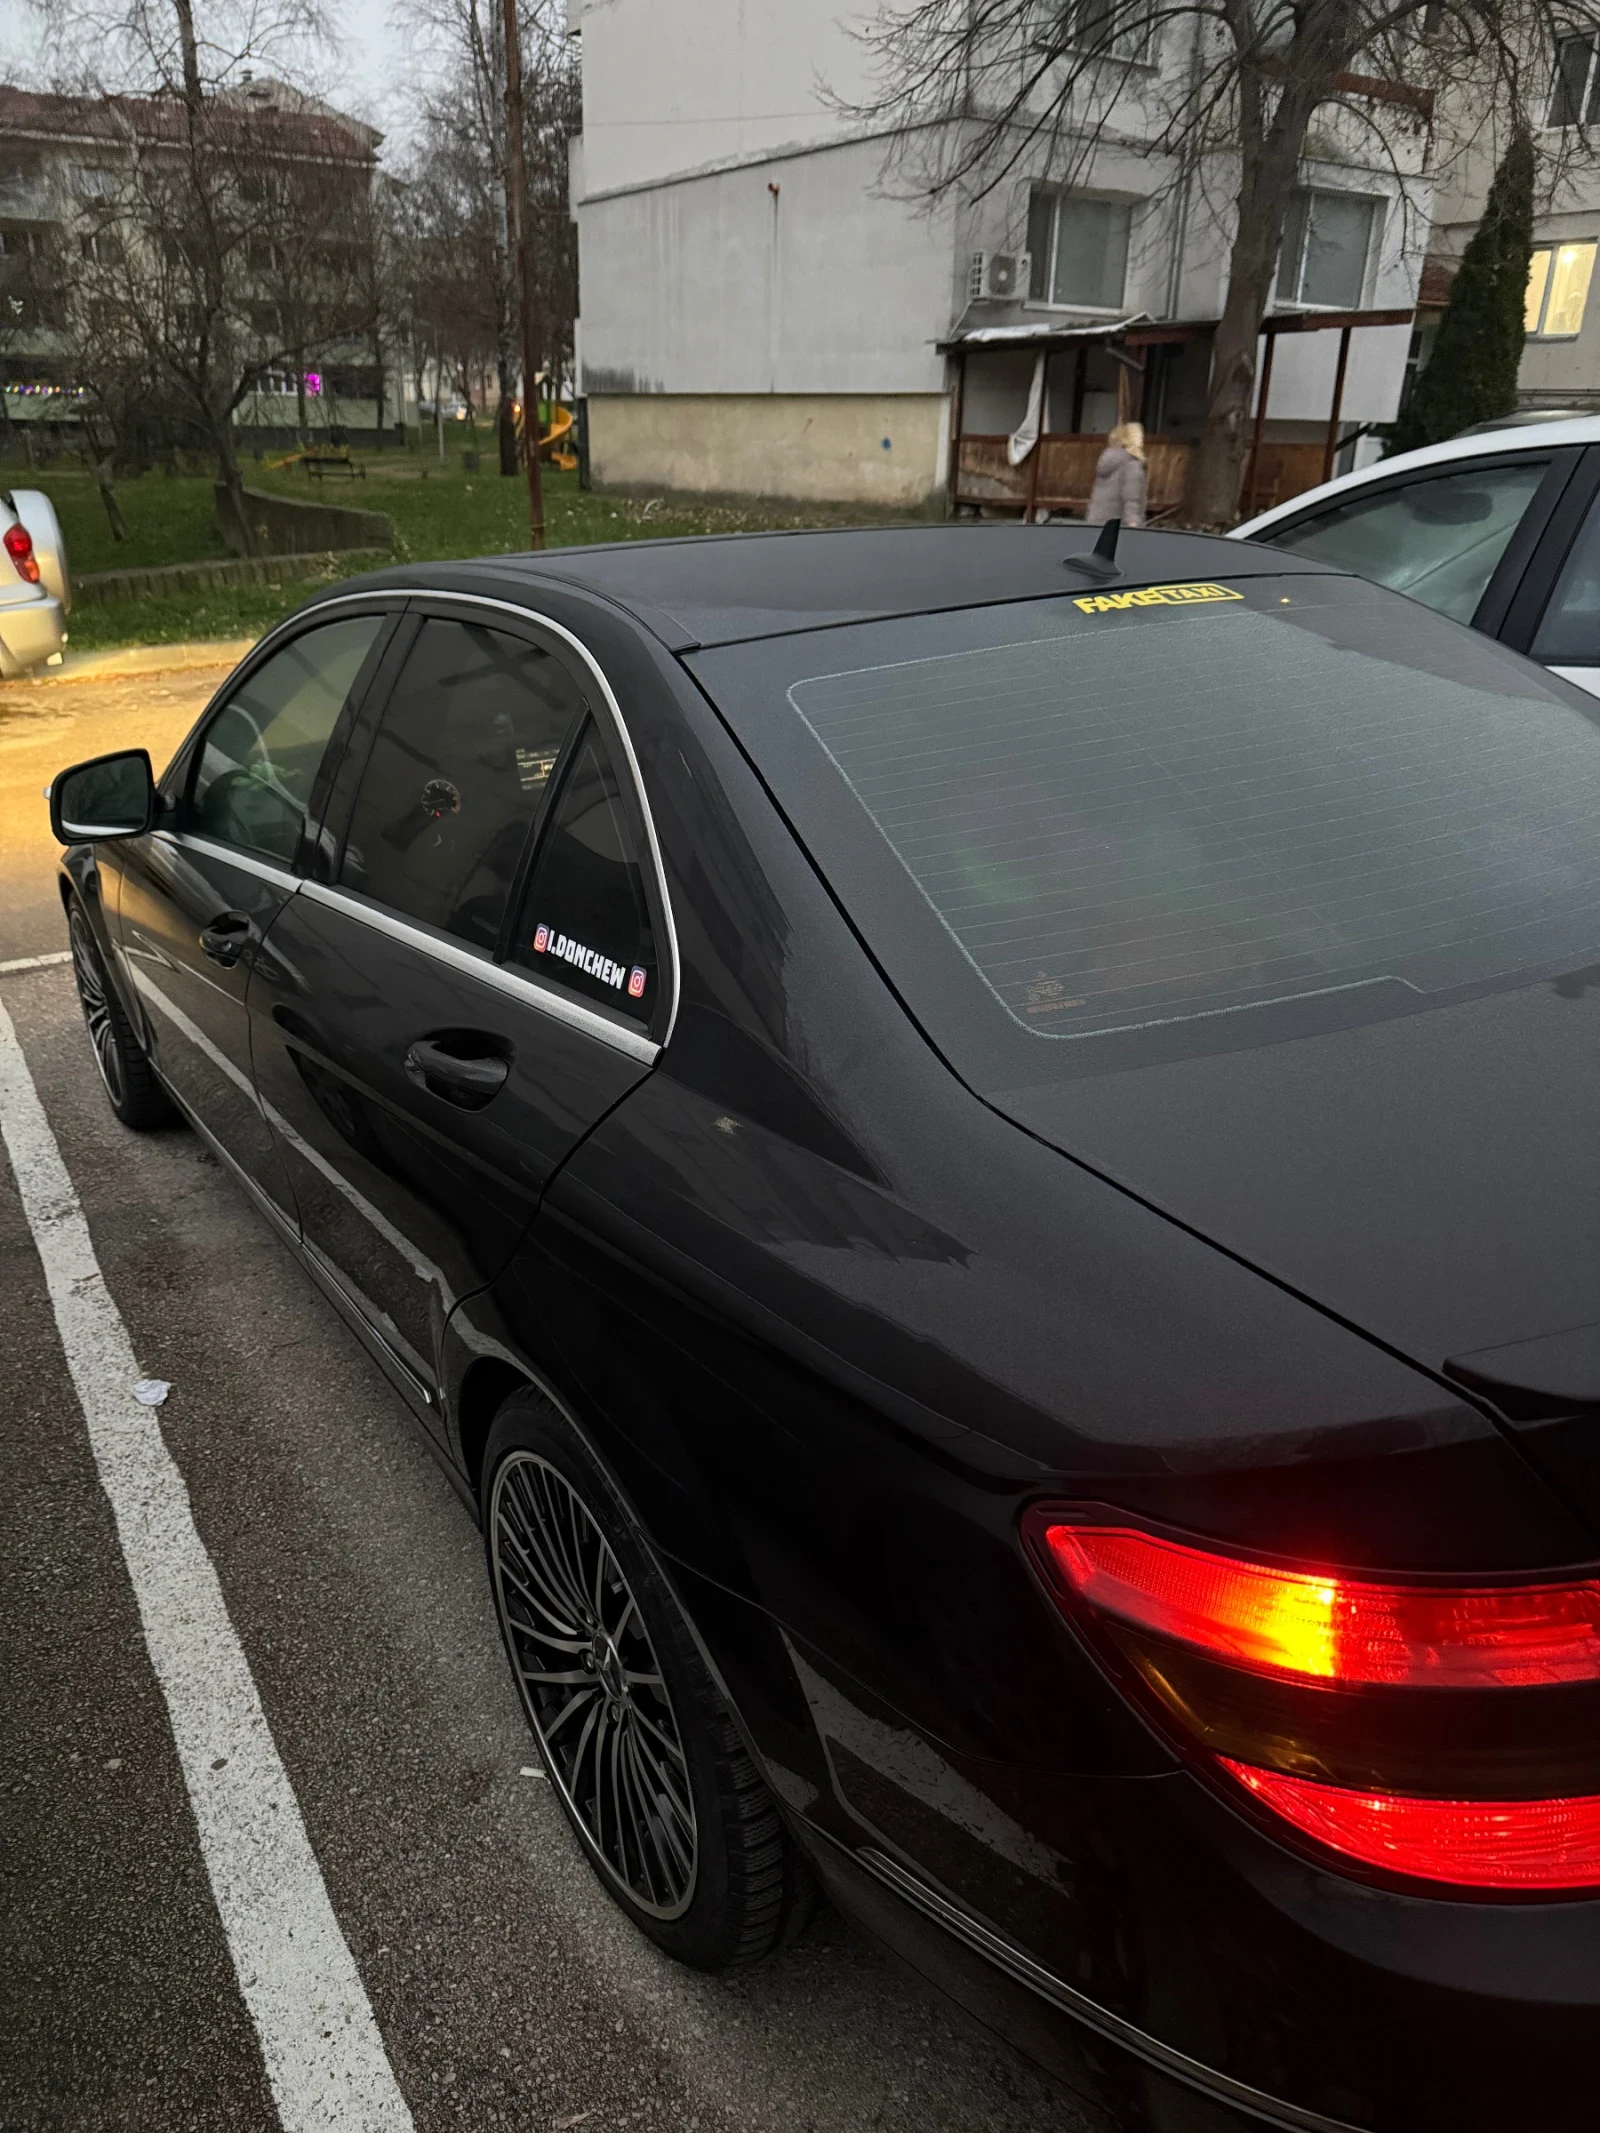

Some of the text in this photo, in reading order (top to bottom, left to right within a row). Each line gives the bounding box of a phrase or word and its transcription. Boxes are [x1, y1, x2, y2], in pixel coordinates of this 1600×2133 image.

[1072, 586, 1227, 614] FAKE TAXI
[546, 929, 626, 990] I.DONCHEW
